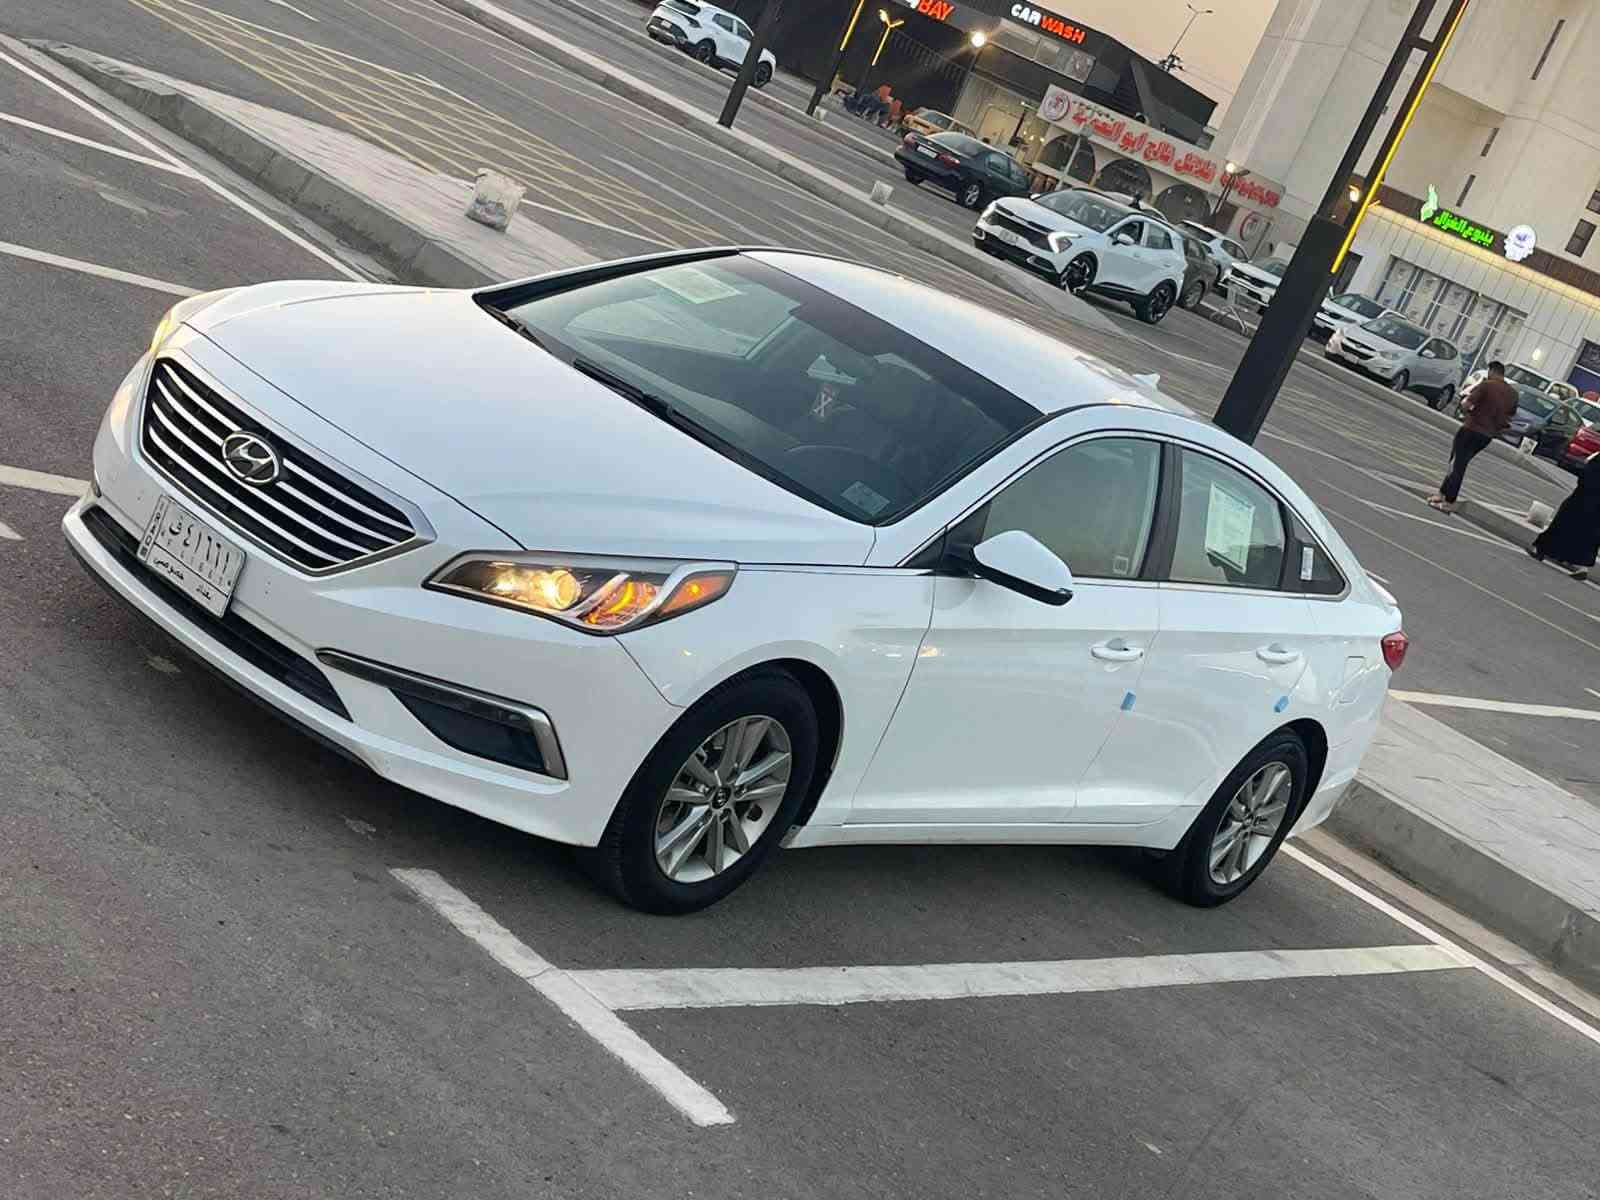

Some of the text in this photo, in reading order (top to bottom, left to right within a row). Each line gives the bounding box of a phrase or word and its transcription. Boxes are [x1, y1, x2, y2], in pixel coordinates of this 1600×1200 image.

[916, 0, 955, 21] BAY
[1010, 3, 1086, 44] CAR WASH
